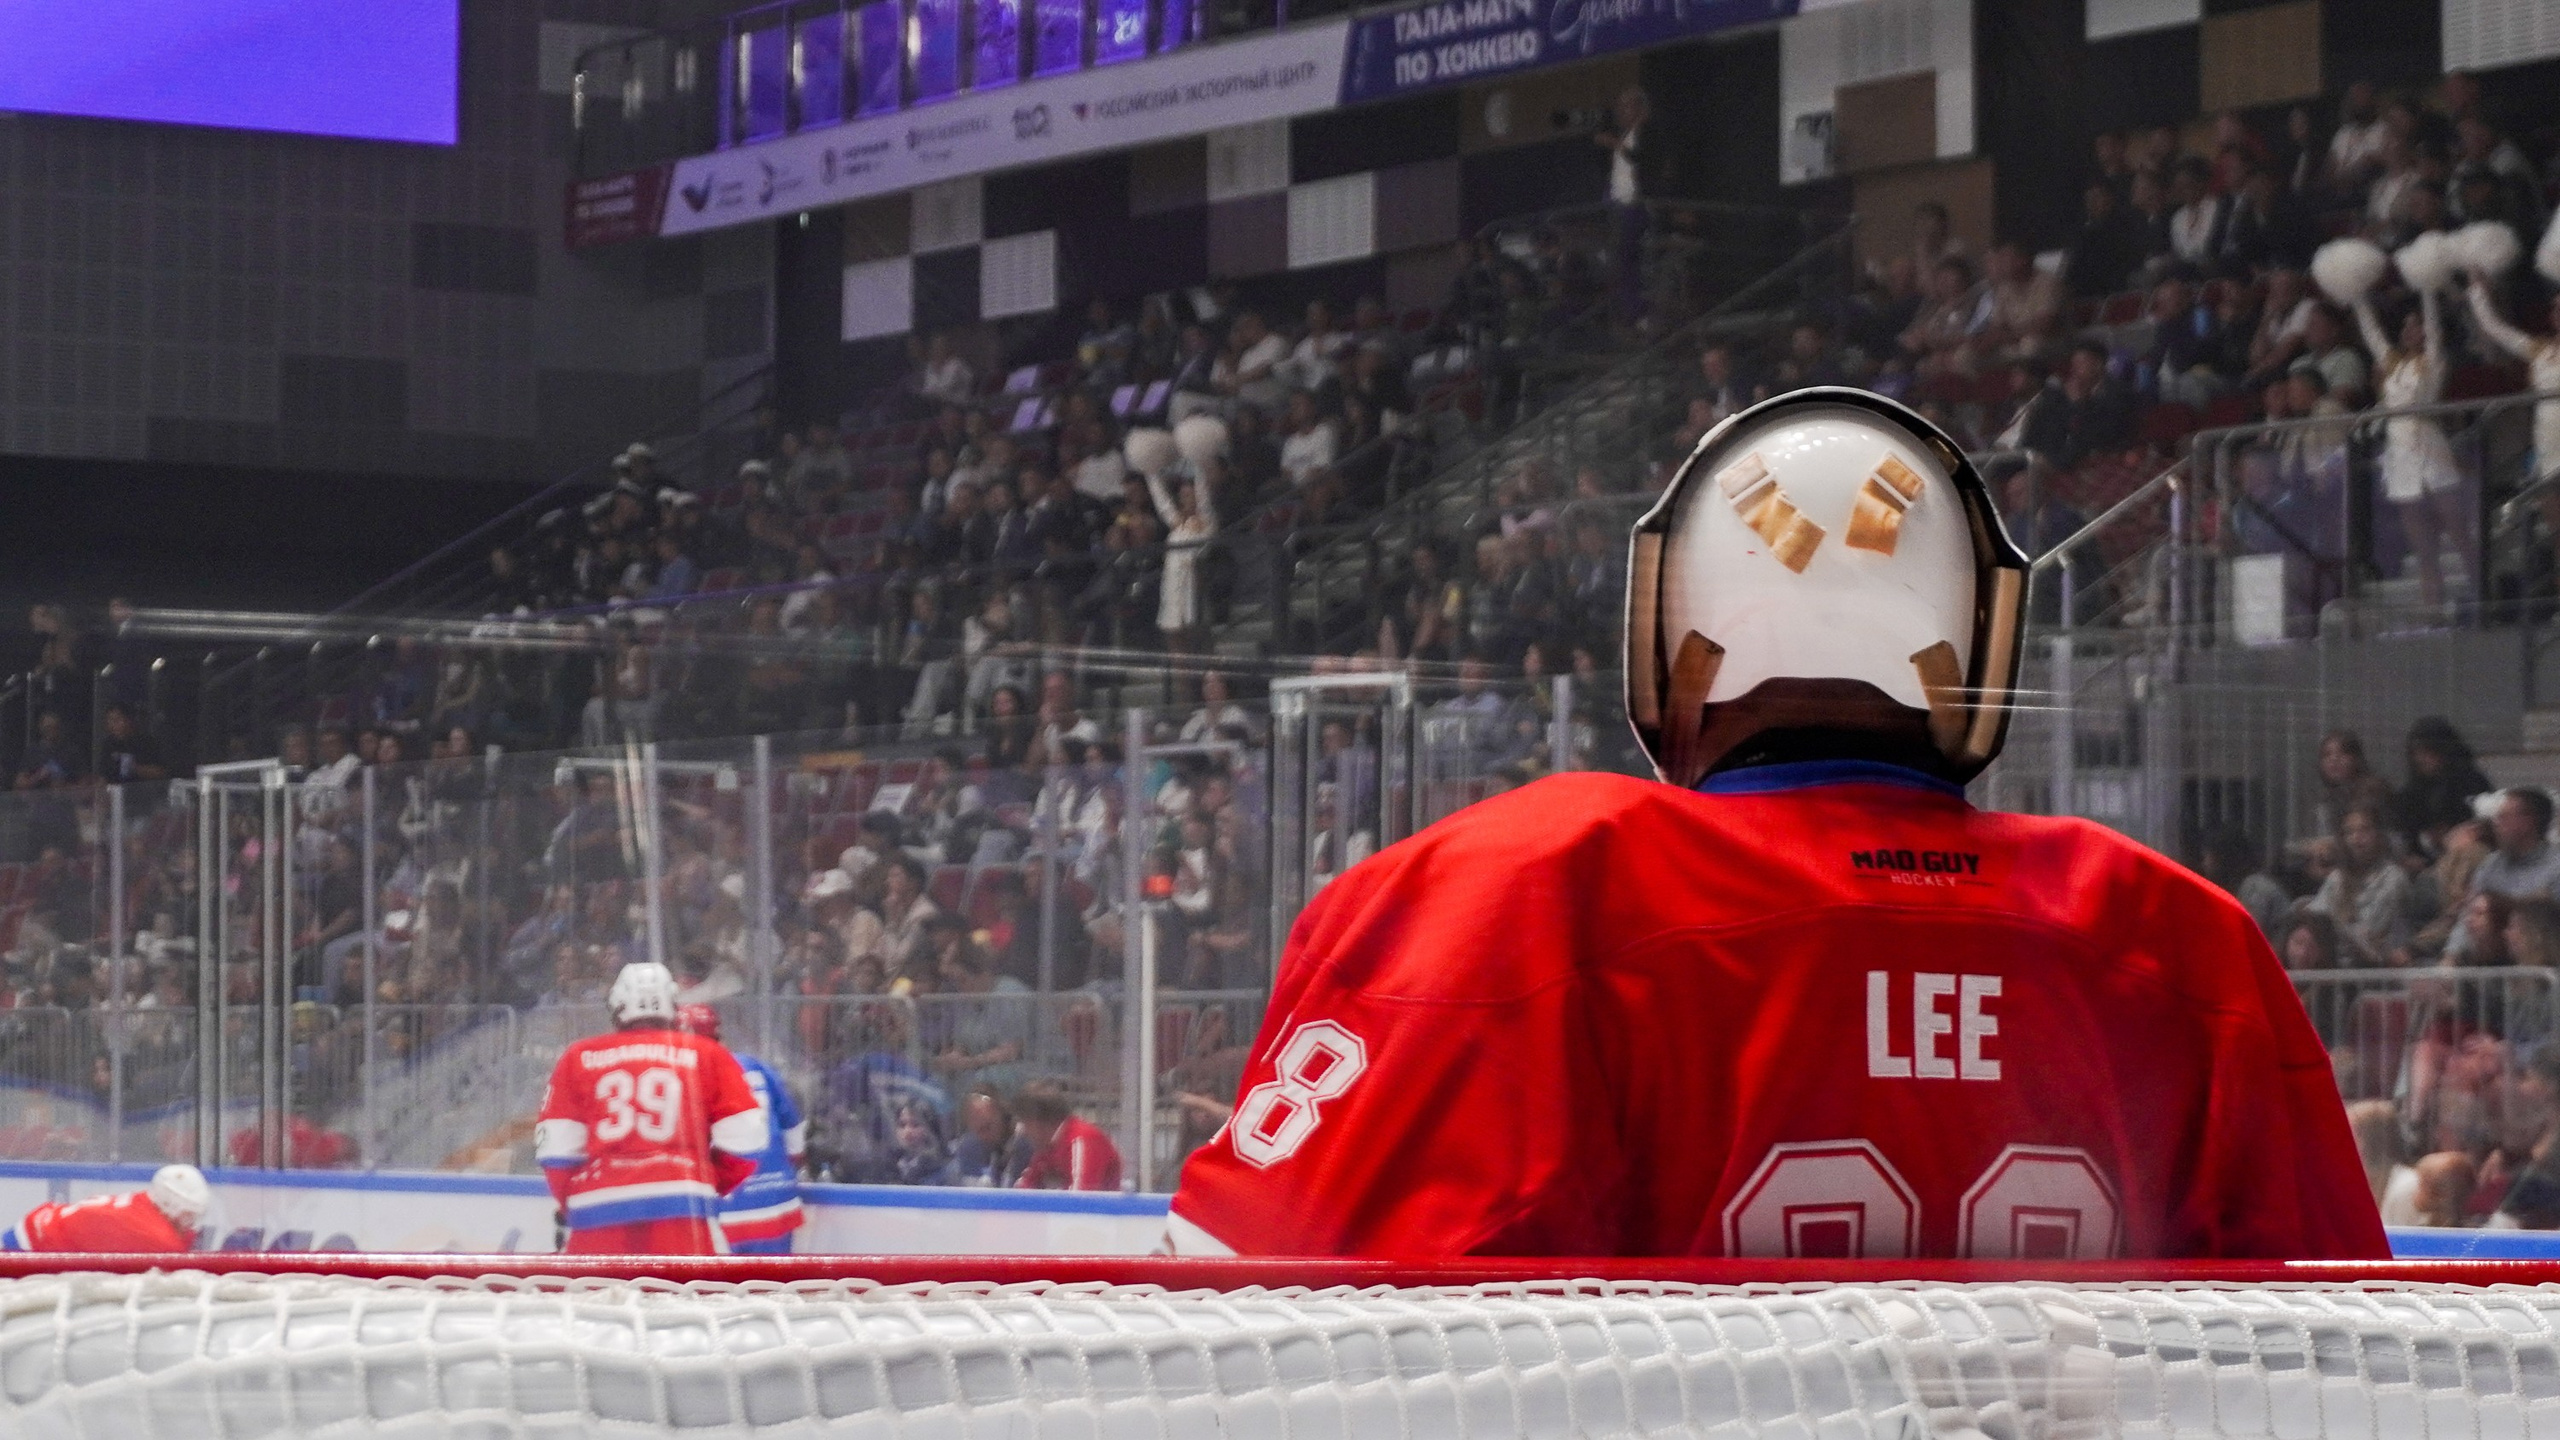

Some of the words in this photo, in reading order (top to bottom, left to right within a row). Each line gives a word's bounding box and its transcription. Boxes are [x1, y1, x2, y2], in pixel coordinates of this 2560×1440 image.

[1394, 50, 1429, 85] ПО
[1435, 29, 1538, 77] ХОККЕЮ
[1851, 849, 1916, 871] MAD
[1921, 851, 1980, 875] GUY
[1891, 873, 1957, 888] HOCKEY
[1866, 970, 2003, 1081] LEE
[595, 1067, 682, 1142] 39
